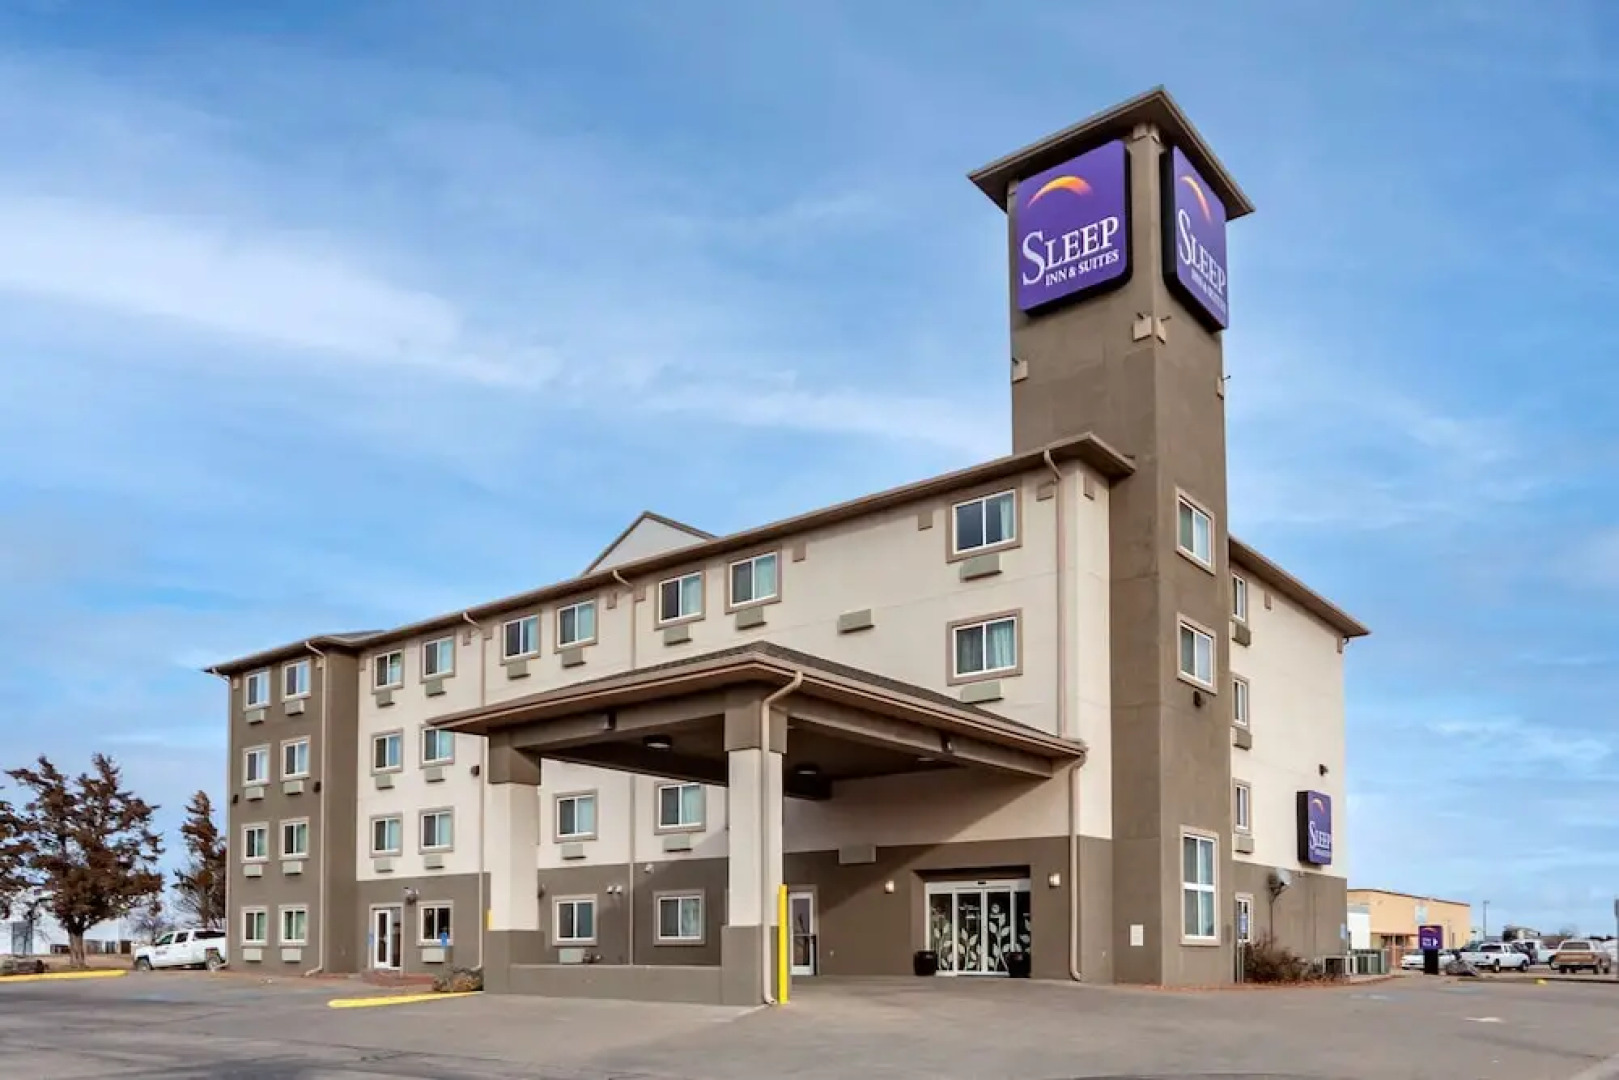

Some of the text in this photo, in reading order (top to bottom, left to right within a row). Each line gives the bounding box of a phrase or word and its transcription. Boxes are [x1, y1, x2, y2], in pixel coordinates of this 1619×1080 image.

[1022, 216, 1119, 286] SLEEP
[1046, 249, 1119, 286] INN & SUITES
[1178, 208, 1227, 294] SLEEP
